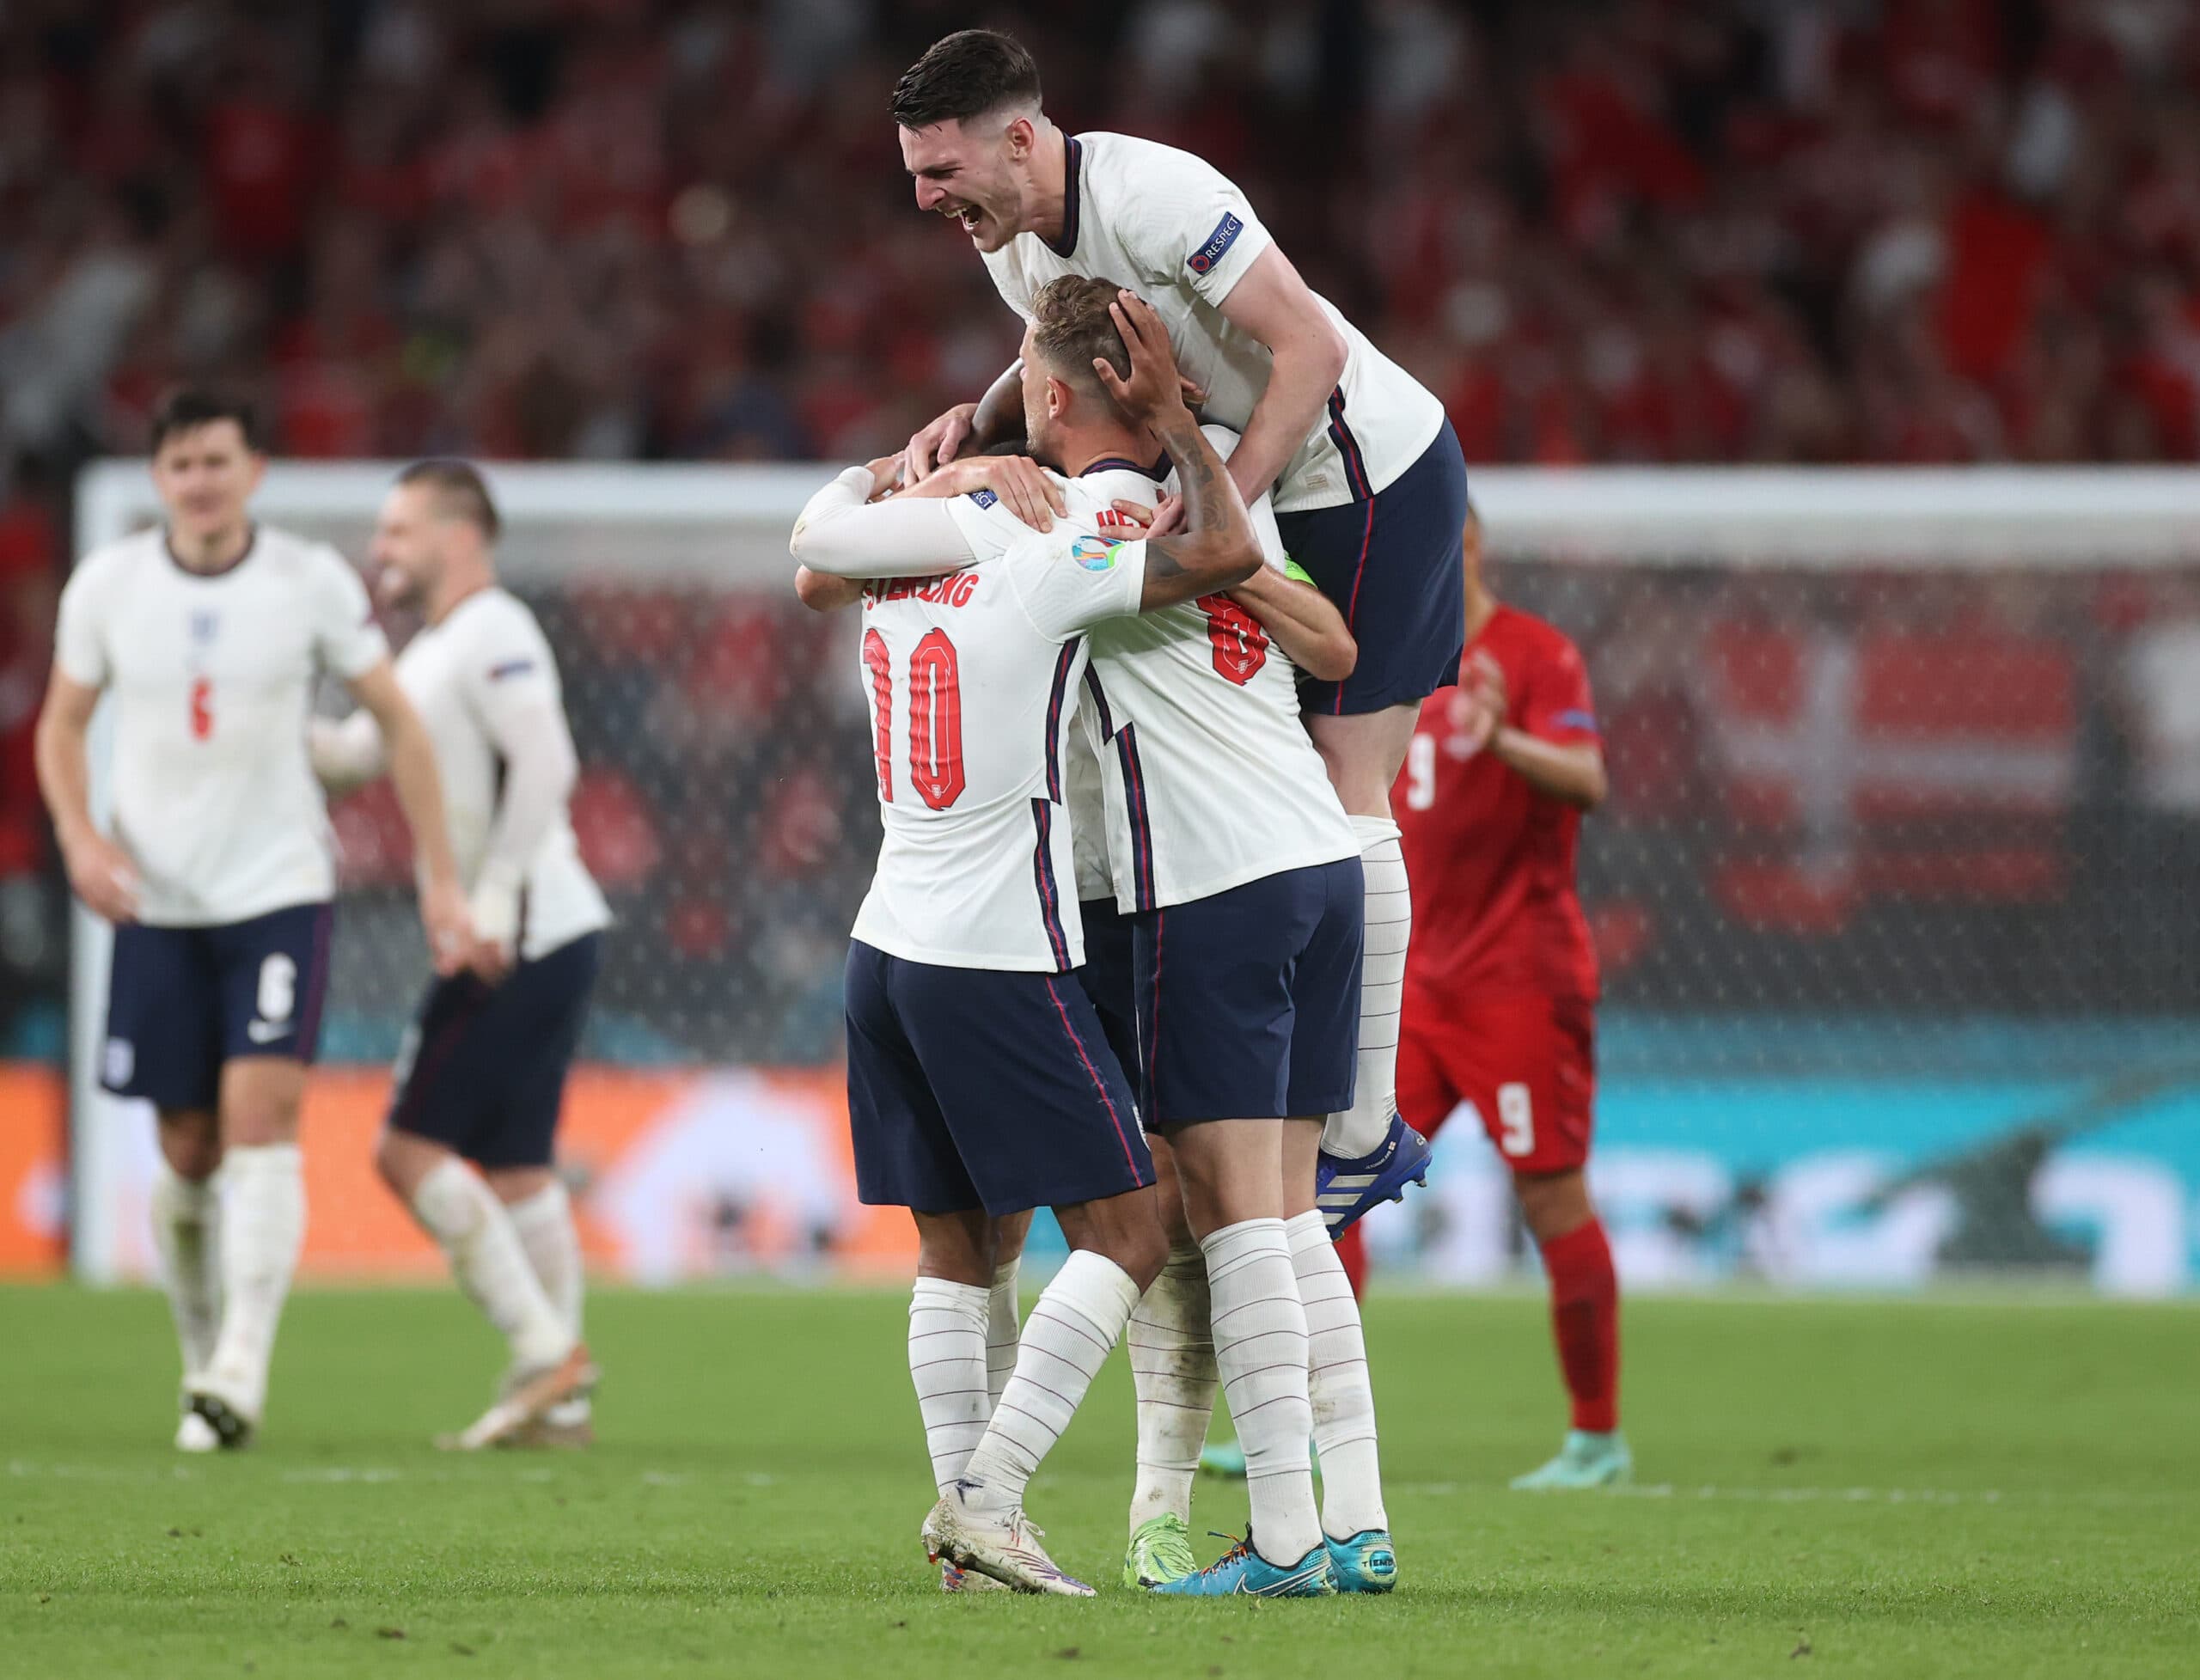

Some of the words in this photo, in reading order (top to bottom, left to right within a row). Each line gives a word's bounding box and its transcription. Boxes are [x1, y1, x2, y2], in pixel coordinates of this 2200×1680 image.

[1205, 215, 1238, 260] RESPECT
[191, 675, 215, 742] 6
[864, 627, 966, 811] 10
[1407, 732, 1436, 811] 9
[257, 951, 297, 1023] 6
[1497, 1082, 1535, 1156] 9
